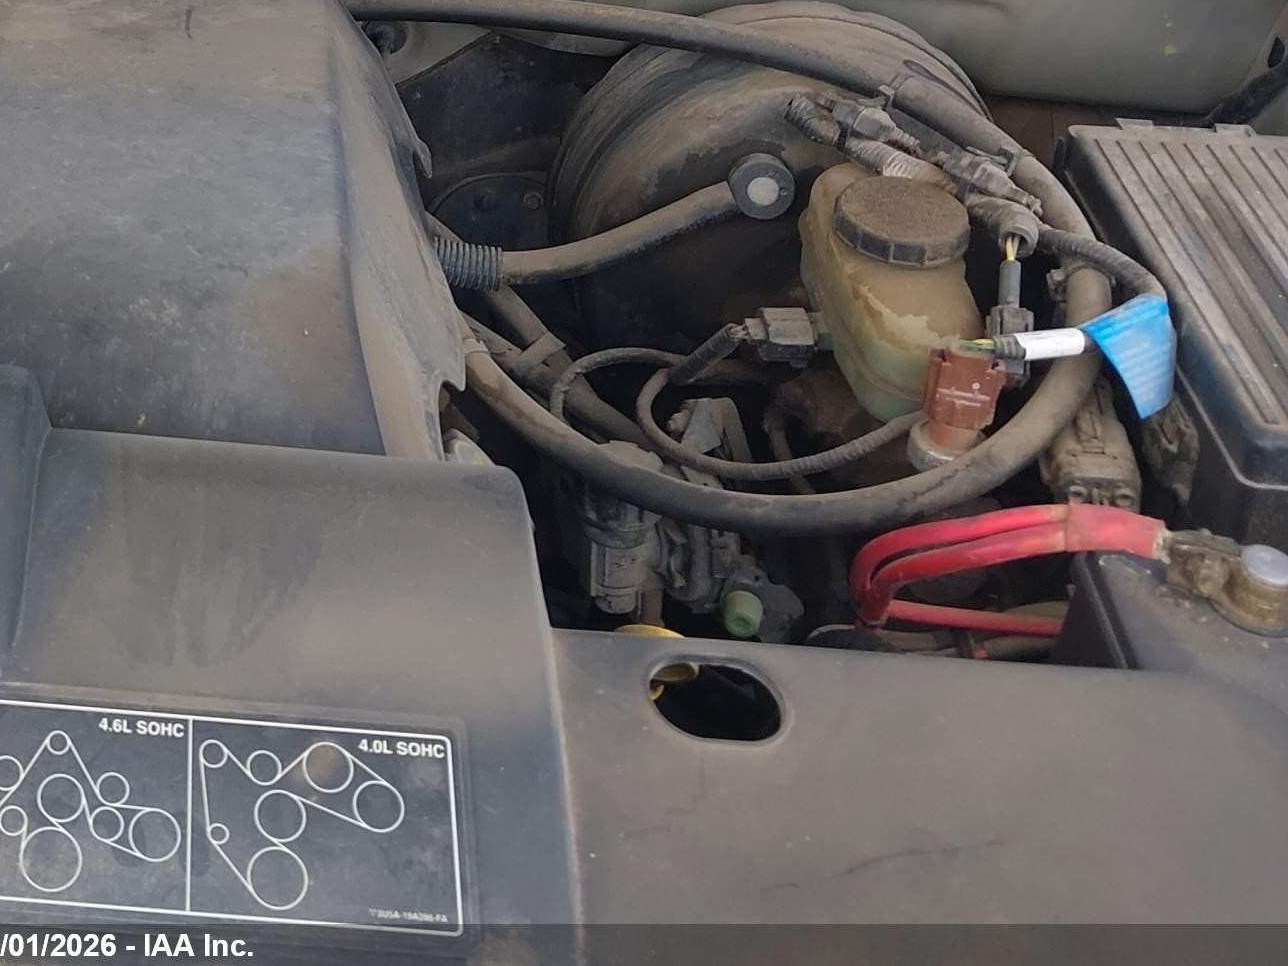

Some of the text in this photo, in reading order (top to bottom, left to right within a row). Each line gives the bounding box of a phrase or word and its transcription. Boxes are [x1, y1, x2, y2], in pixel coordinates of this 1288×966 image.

[99, 718, 184, 738] 4.6L SOHC
[359, 738, 446, 759] 4.0L SOHC
